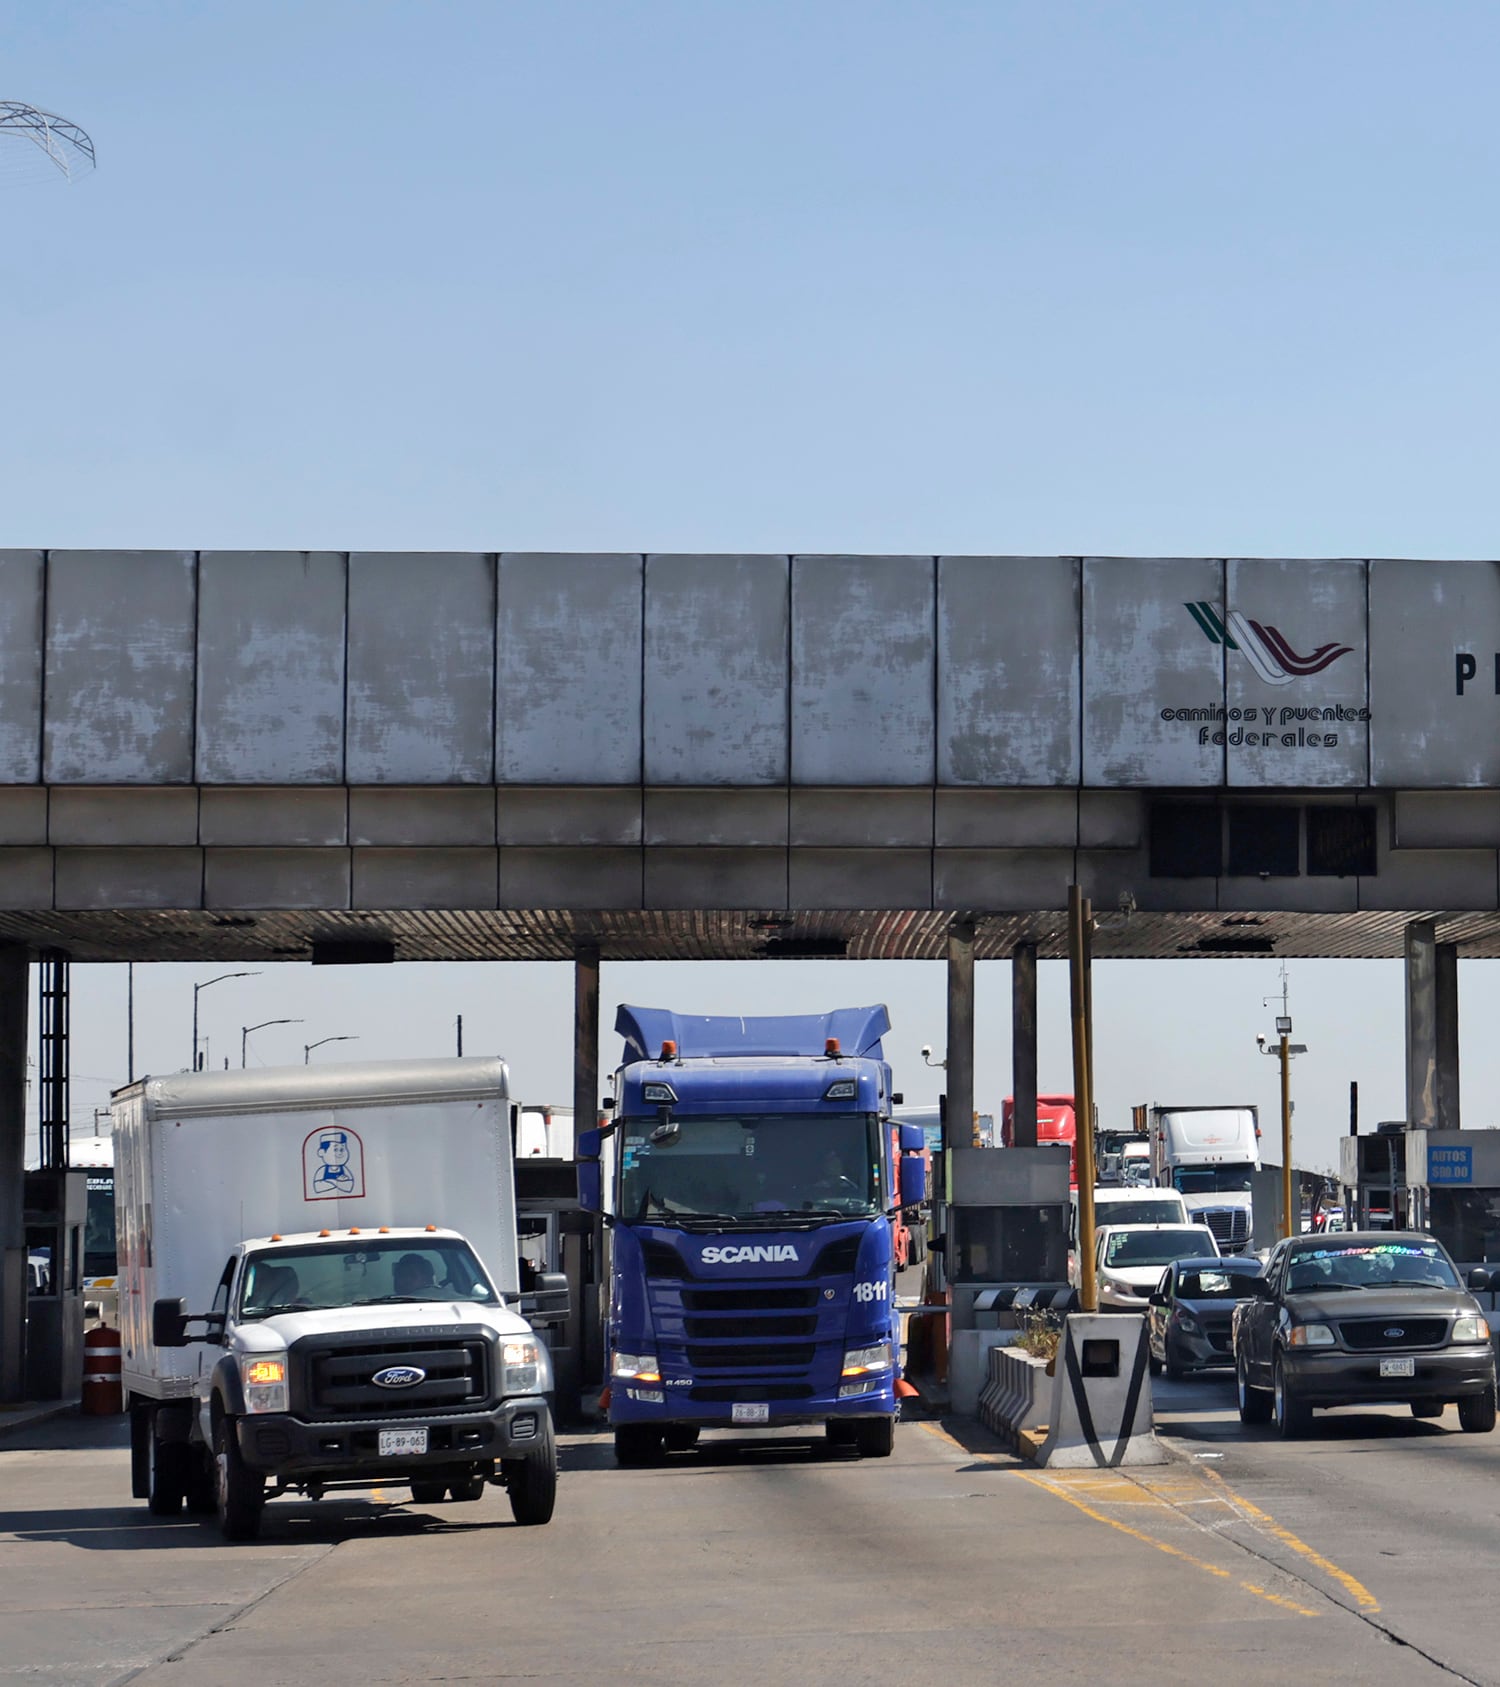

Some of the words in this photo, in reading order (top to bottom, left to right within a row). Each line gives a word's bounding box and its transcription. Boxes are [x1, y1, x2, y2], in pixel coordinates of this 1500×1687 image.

[1160, 703, 1257, 721] caminos
[1280, 704, 1372, 725] puentes
[1198, 726, 1338, 747] federales
[1432, 1150, 1467, 1162] AUTOS
[701, 1245, 799, 1264] SCANIA
[853, 1280, 887, 1302] 1811
[384, 1371, 413, 1384] Ford
[381, 1436, 425, 1449] LG-89-063
